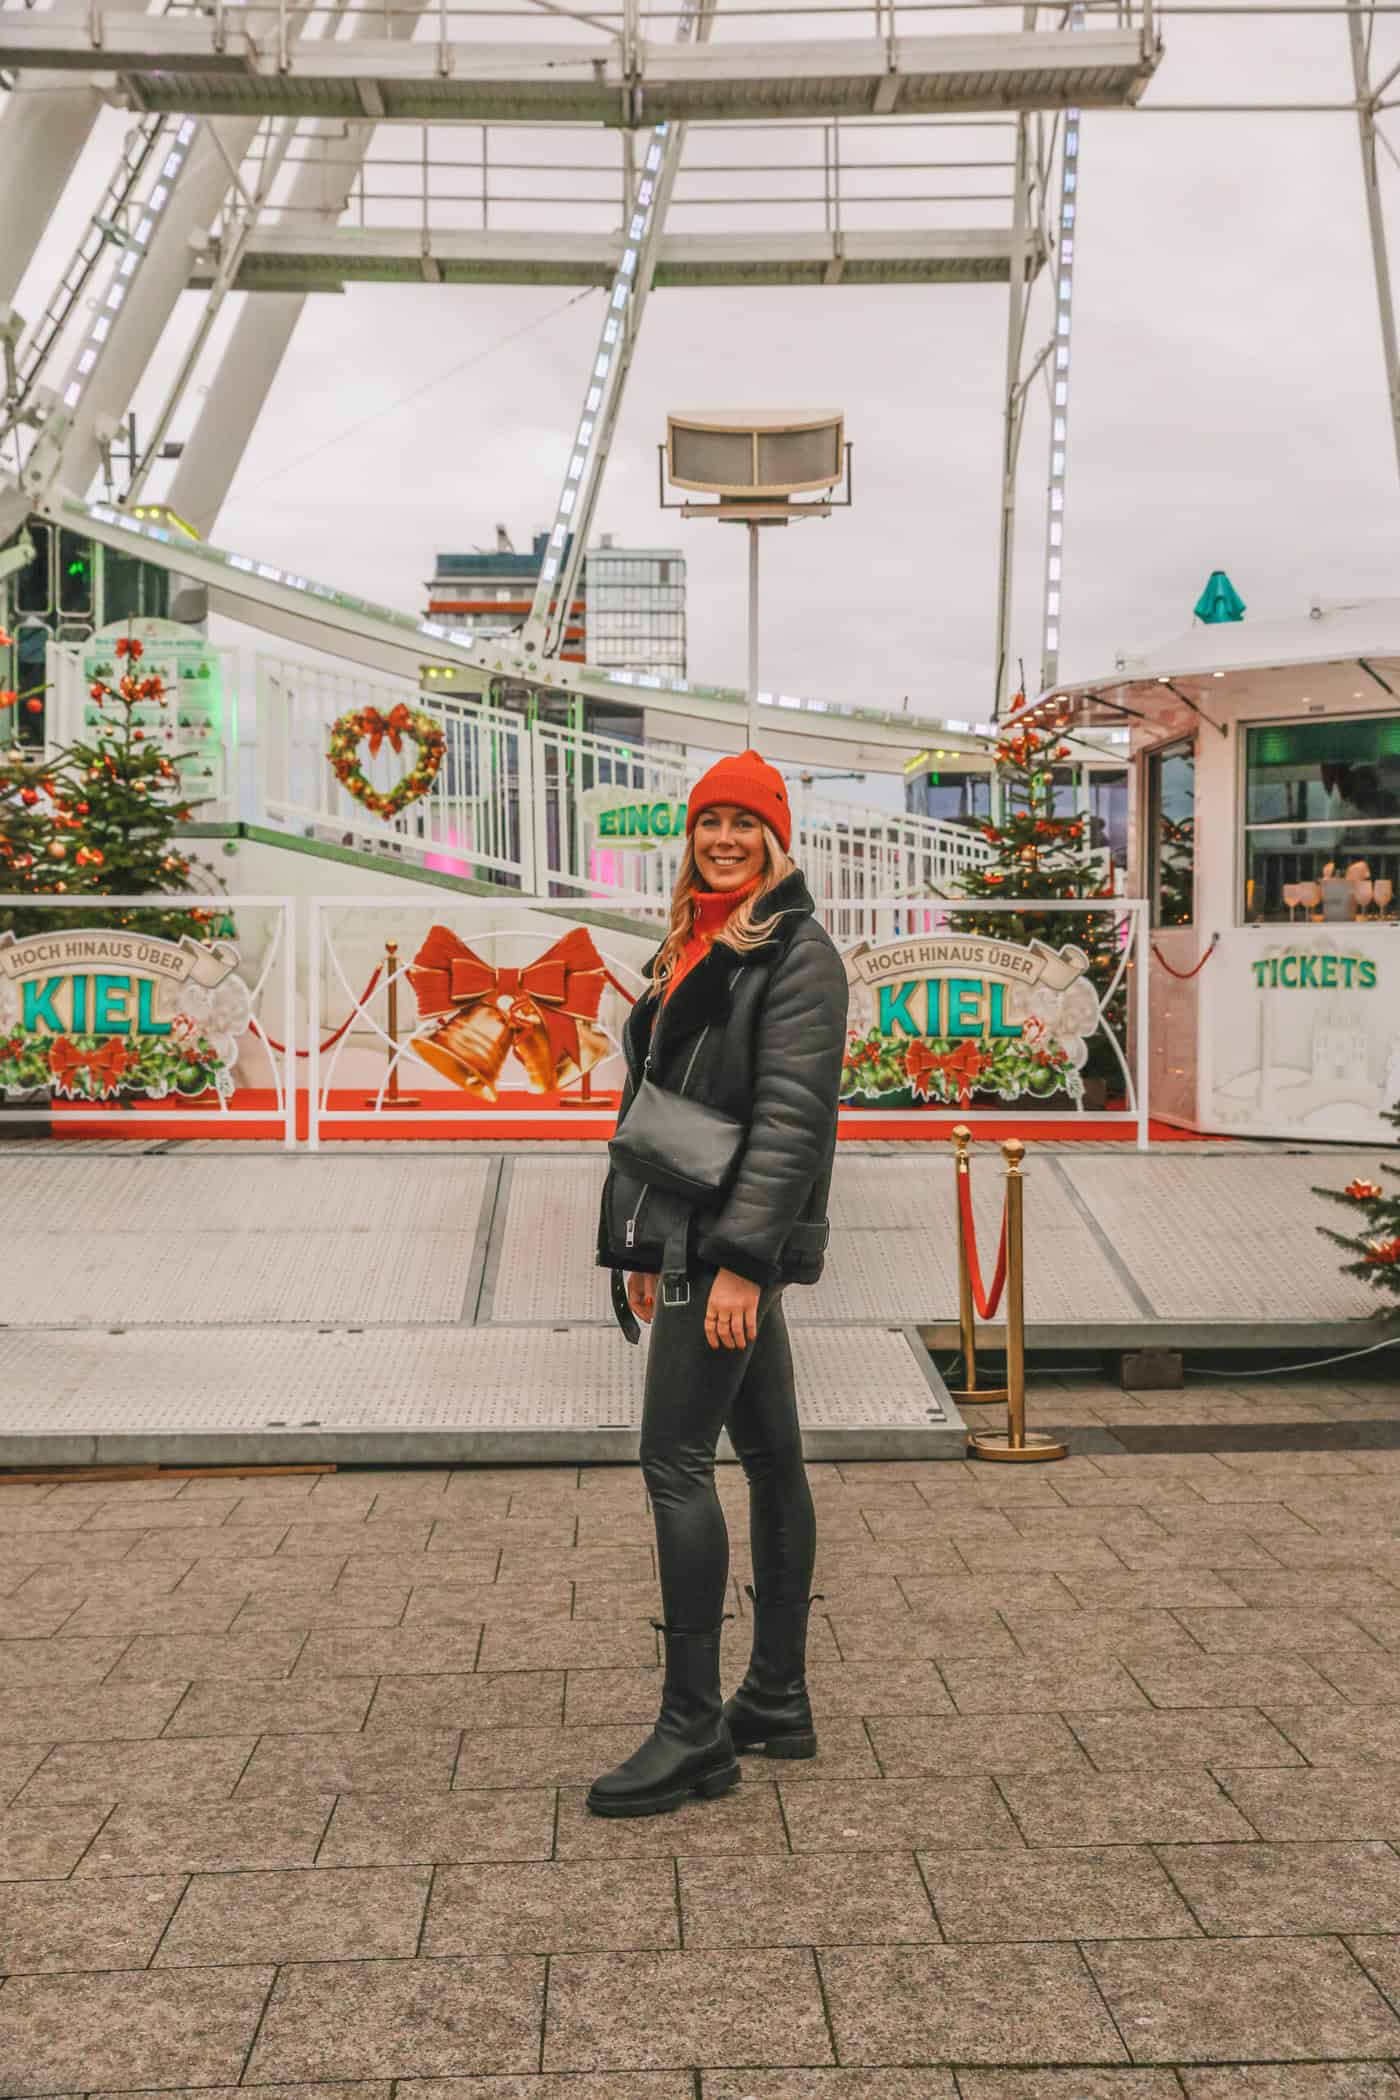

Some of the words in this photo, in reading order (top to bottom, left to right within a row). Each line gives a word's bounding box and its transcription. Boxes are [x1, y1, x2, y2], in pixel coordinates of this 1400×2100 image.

[10, 942, 61, 969] HOCH
[65, 941, 134, 960] HINAUS
[136, 940, 185, 972] ÜBER
[866, 947, 915, 974] HOCH
[919, 945, 984, 963] HINAUS
[988, 946, 1034, 976] ÜBER
[1252, 954, 1377, 989] TICKETS
[21, 974, 174, 1036] KIEL
[879, 978, 1024, 1039] KIEL
